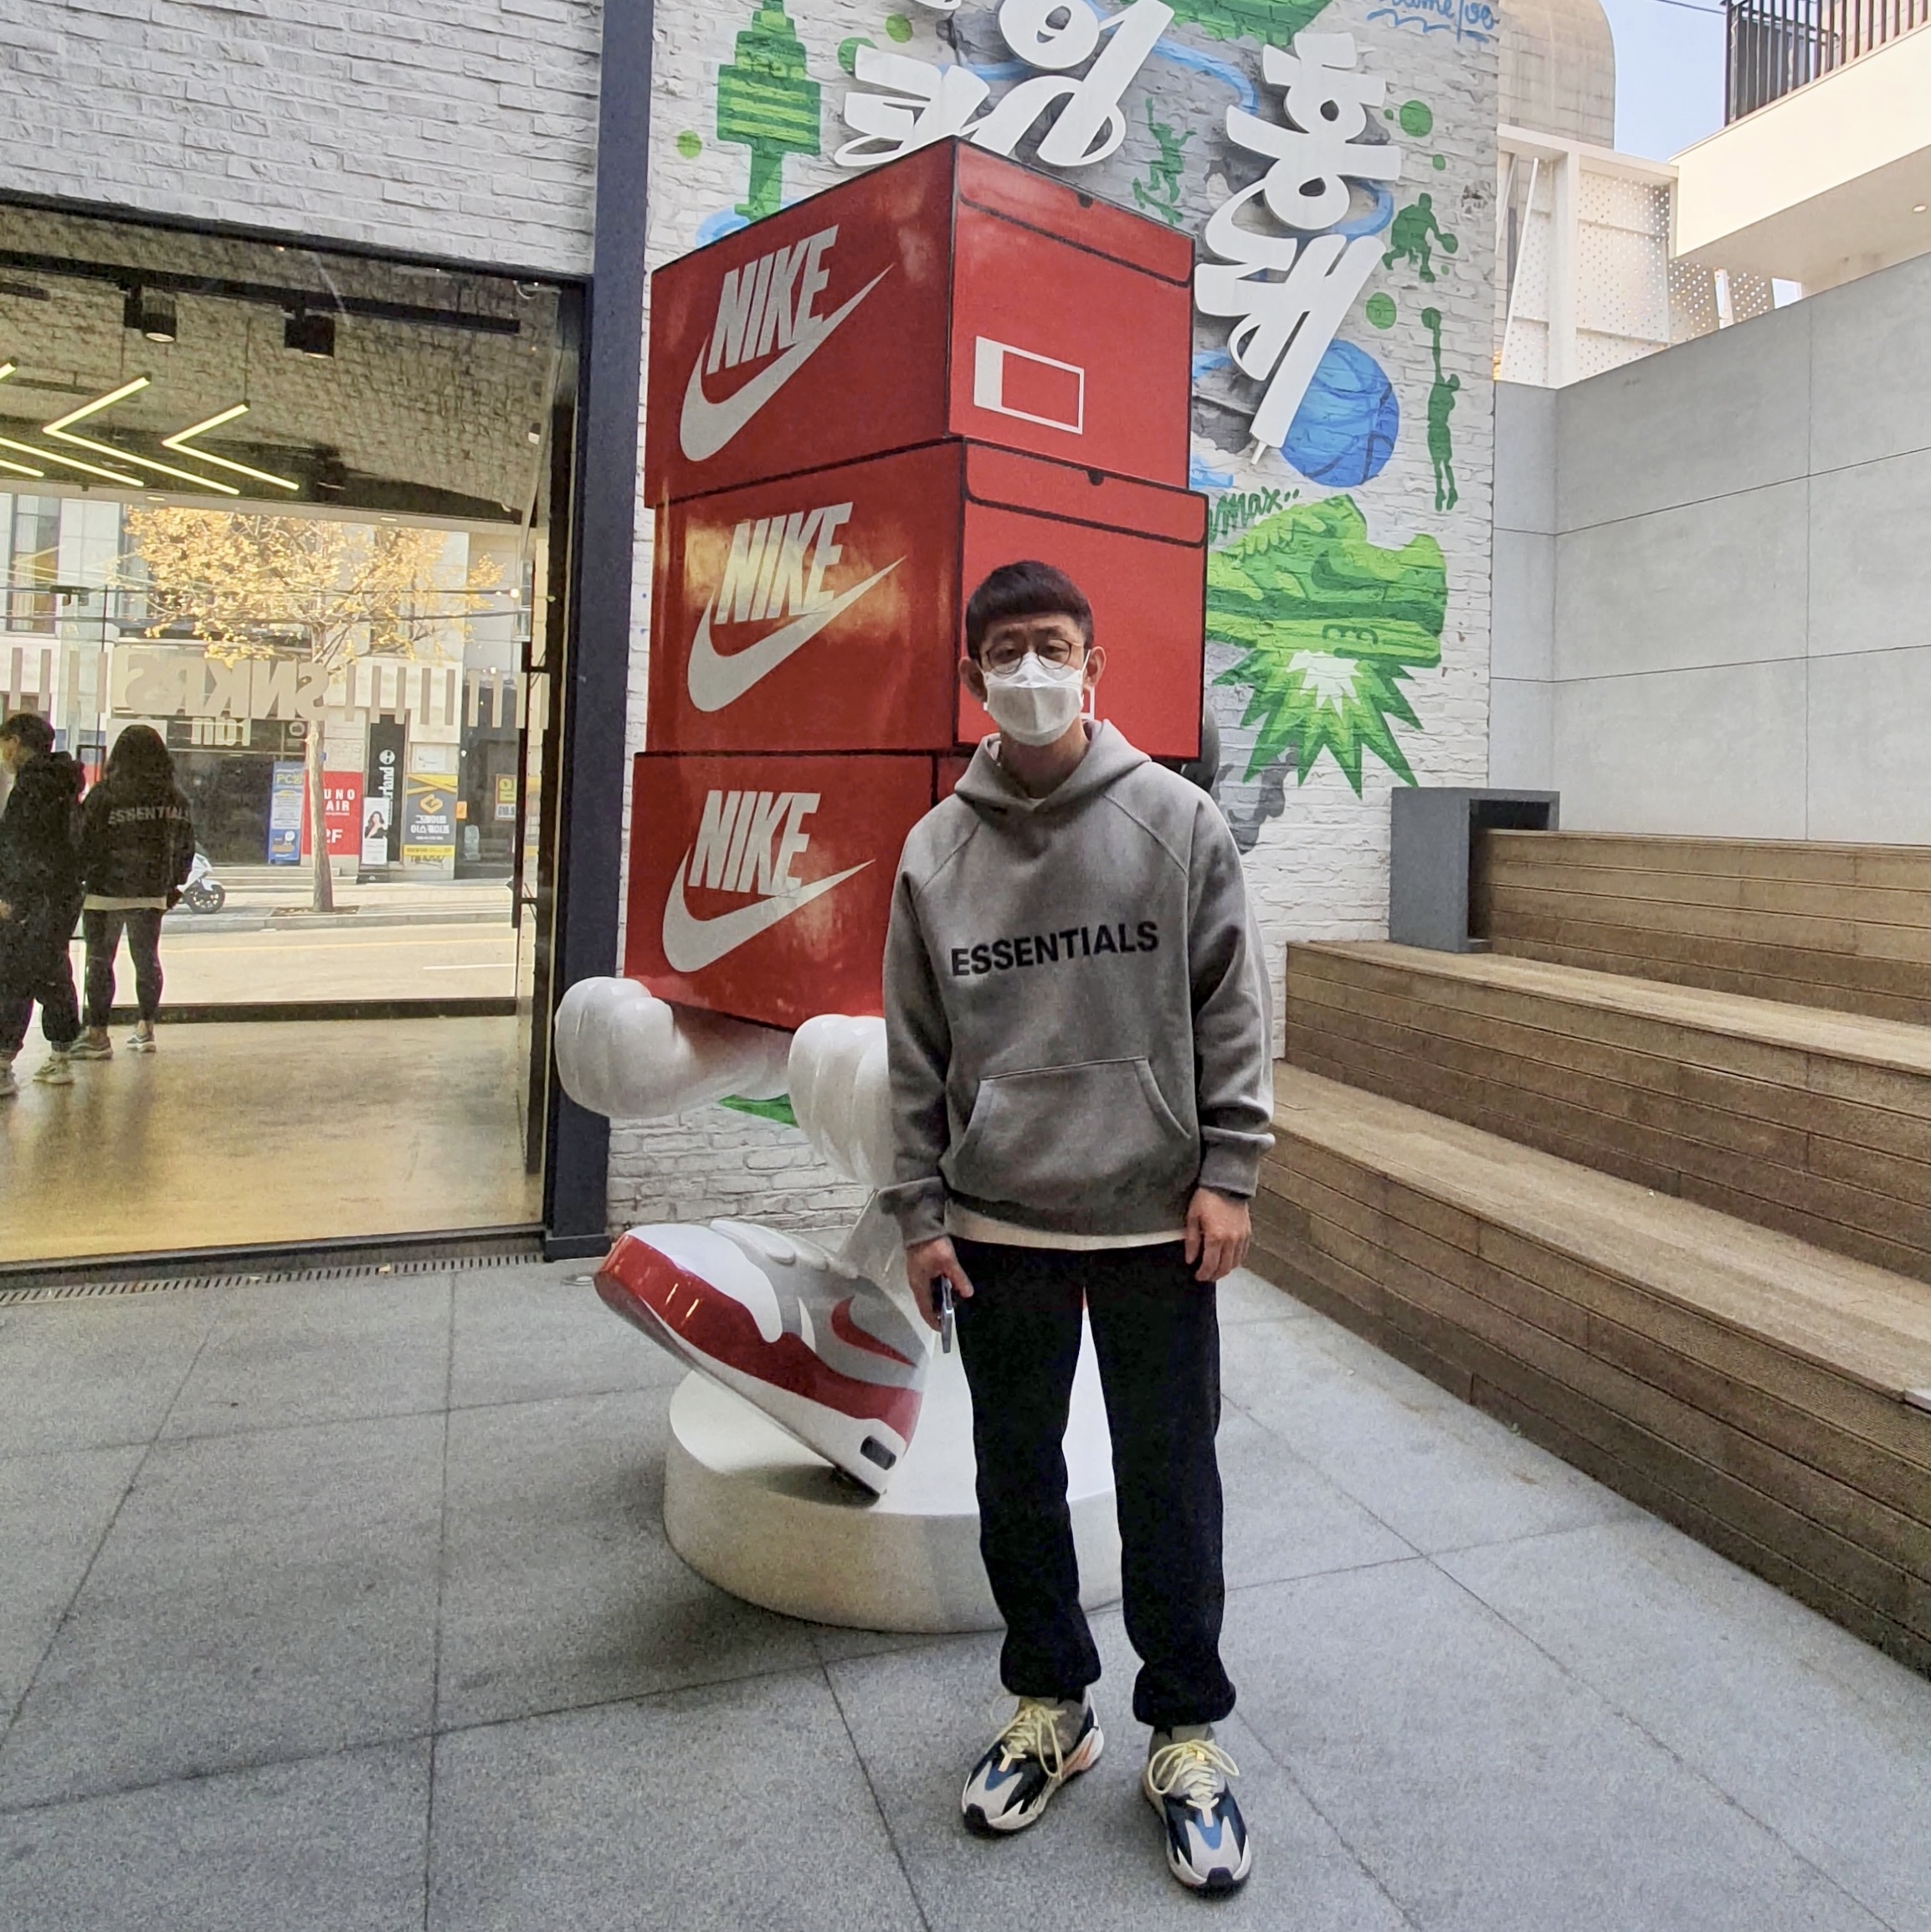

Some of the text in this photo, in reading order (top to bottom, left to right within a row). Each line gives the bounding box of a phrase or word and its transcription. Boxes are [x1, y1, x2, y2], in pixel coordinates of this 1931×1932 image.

[706, 224, 840, 376] NIKE
[714, 501, 854, 625] NIKE
[323, 789, 356, 800] UNO
[326, 800, 350, 811] AIR
[687, 789, 821, 898] NIKE
[951, 921, 1159, 976] ESSENTIALS
